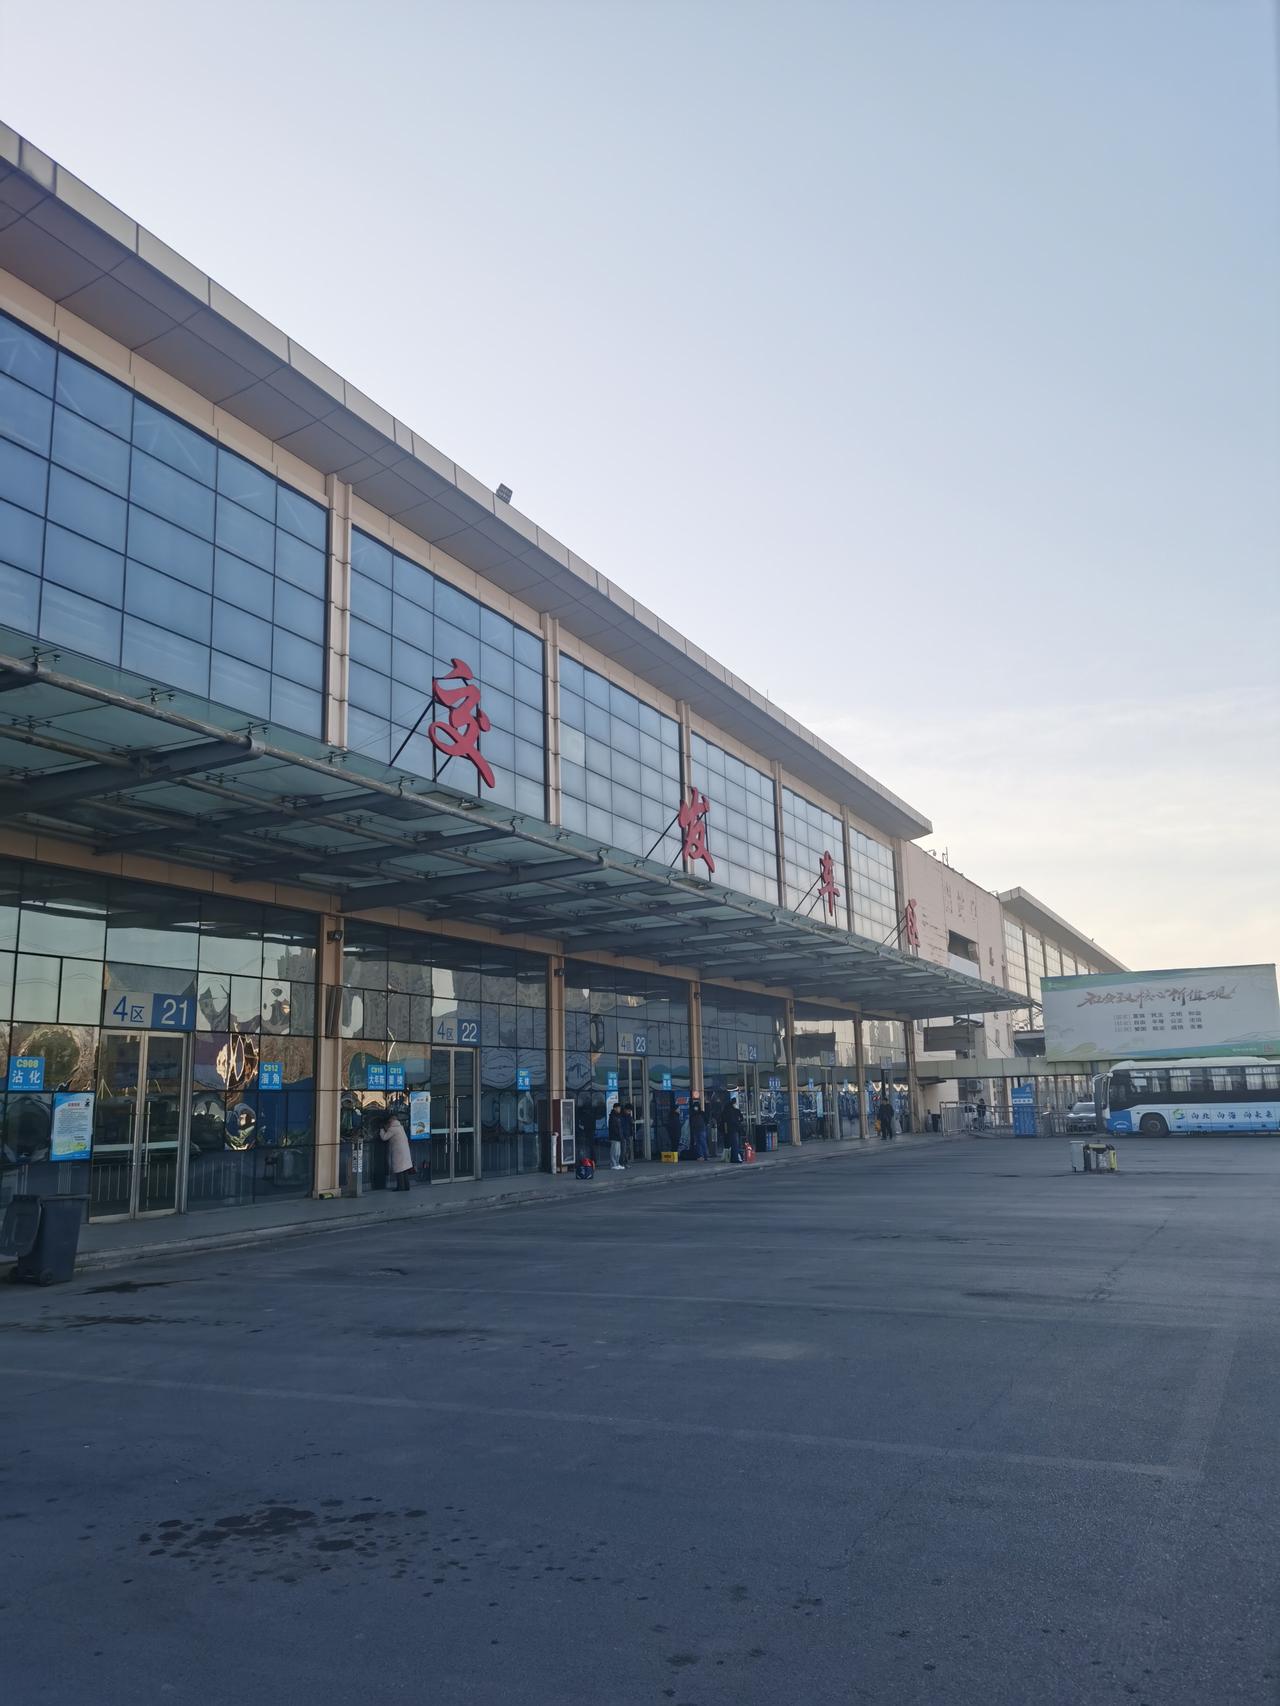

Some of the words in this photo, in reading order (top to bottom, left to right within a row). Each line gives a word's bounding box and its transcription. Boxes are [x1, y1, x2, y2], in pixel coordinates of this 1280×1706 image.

[113, 995, 144, 1023] 4区
[161, 998, 187, 1025] 21
[437, 1020, 454, 1041] 4区
[461, 1022, 477, 1042] 22
[636, 1036, 646, 1053] 23
[749, 1046, 757, 1060] 24
[12, 1070, 41, 1084] 沾化
